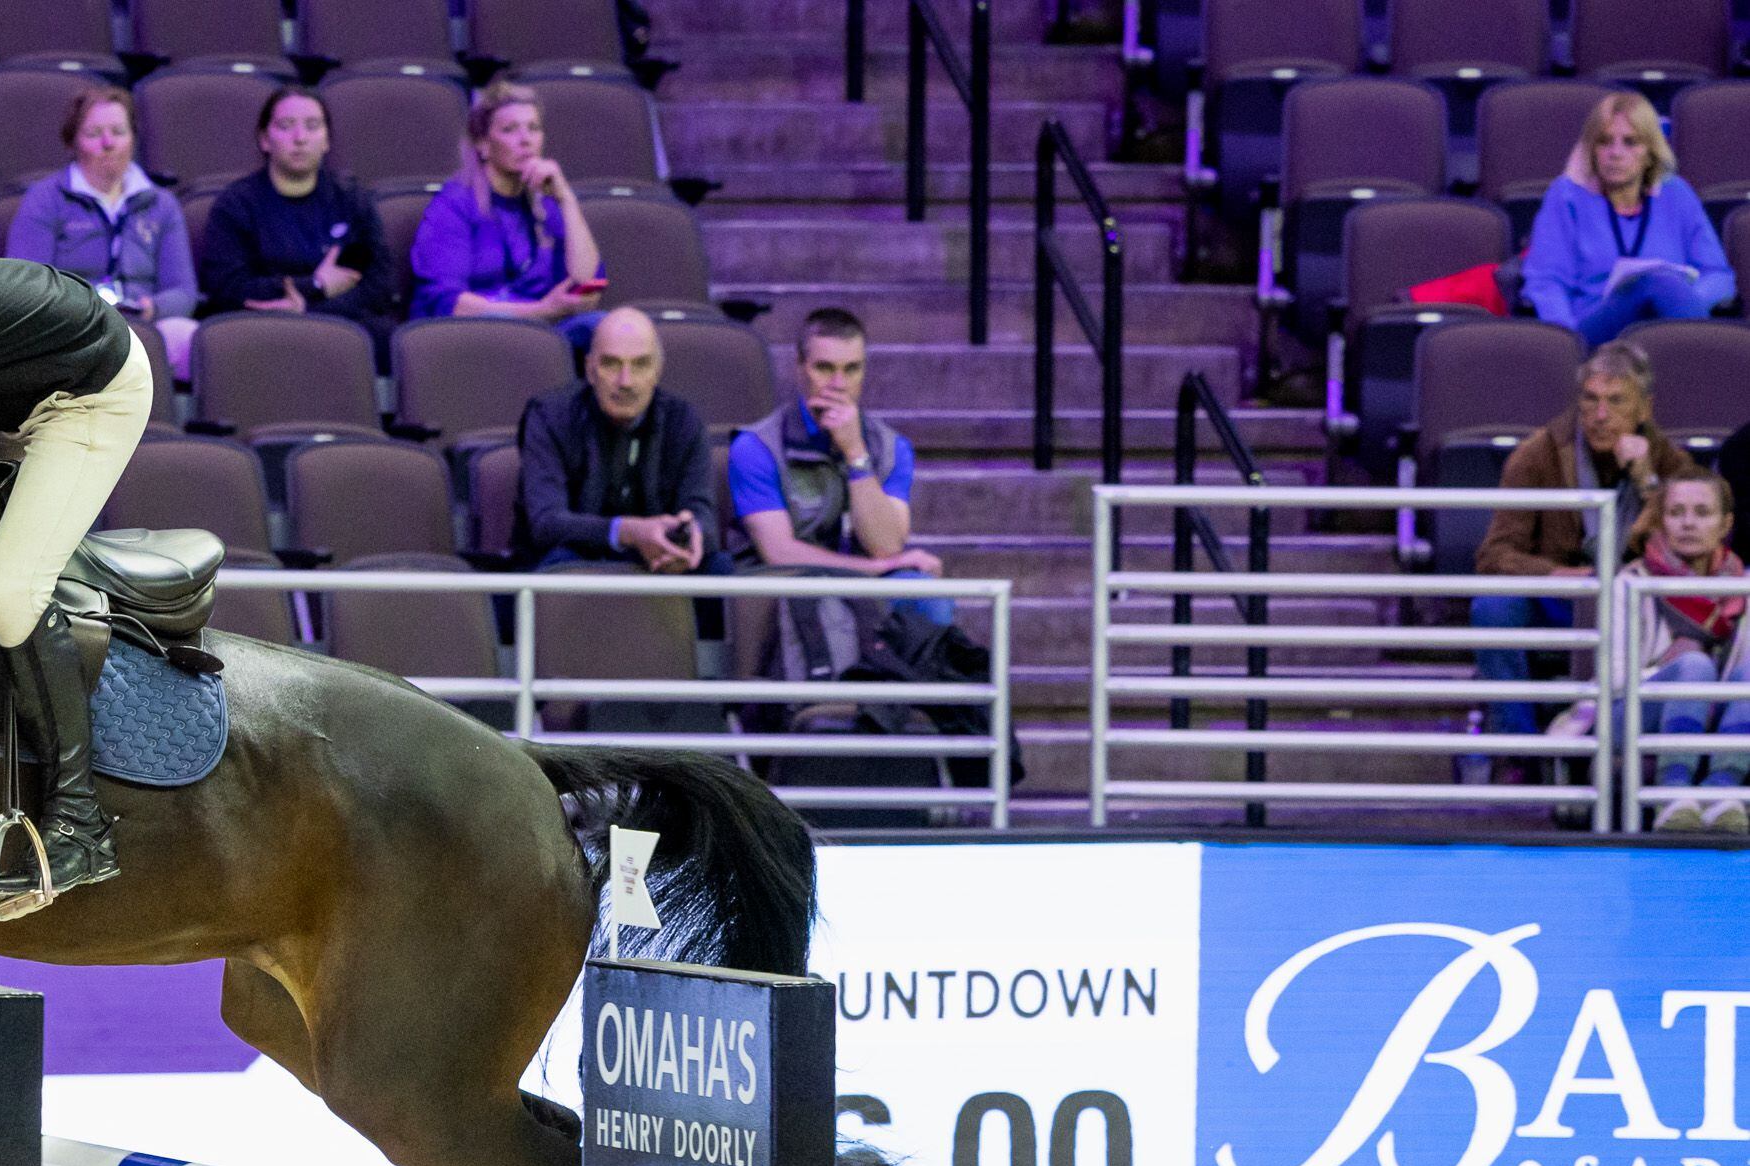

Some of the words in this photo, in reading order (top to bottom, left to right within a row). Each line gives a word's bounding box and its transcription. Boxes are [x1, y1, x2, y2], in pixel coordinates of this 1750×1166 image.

[810, 968, 1157, 1021] UNTDOWN
[596, 1002, 757, 1105] OMAHA'S
[596, 1108, 664, 1155] HENRY
